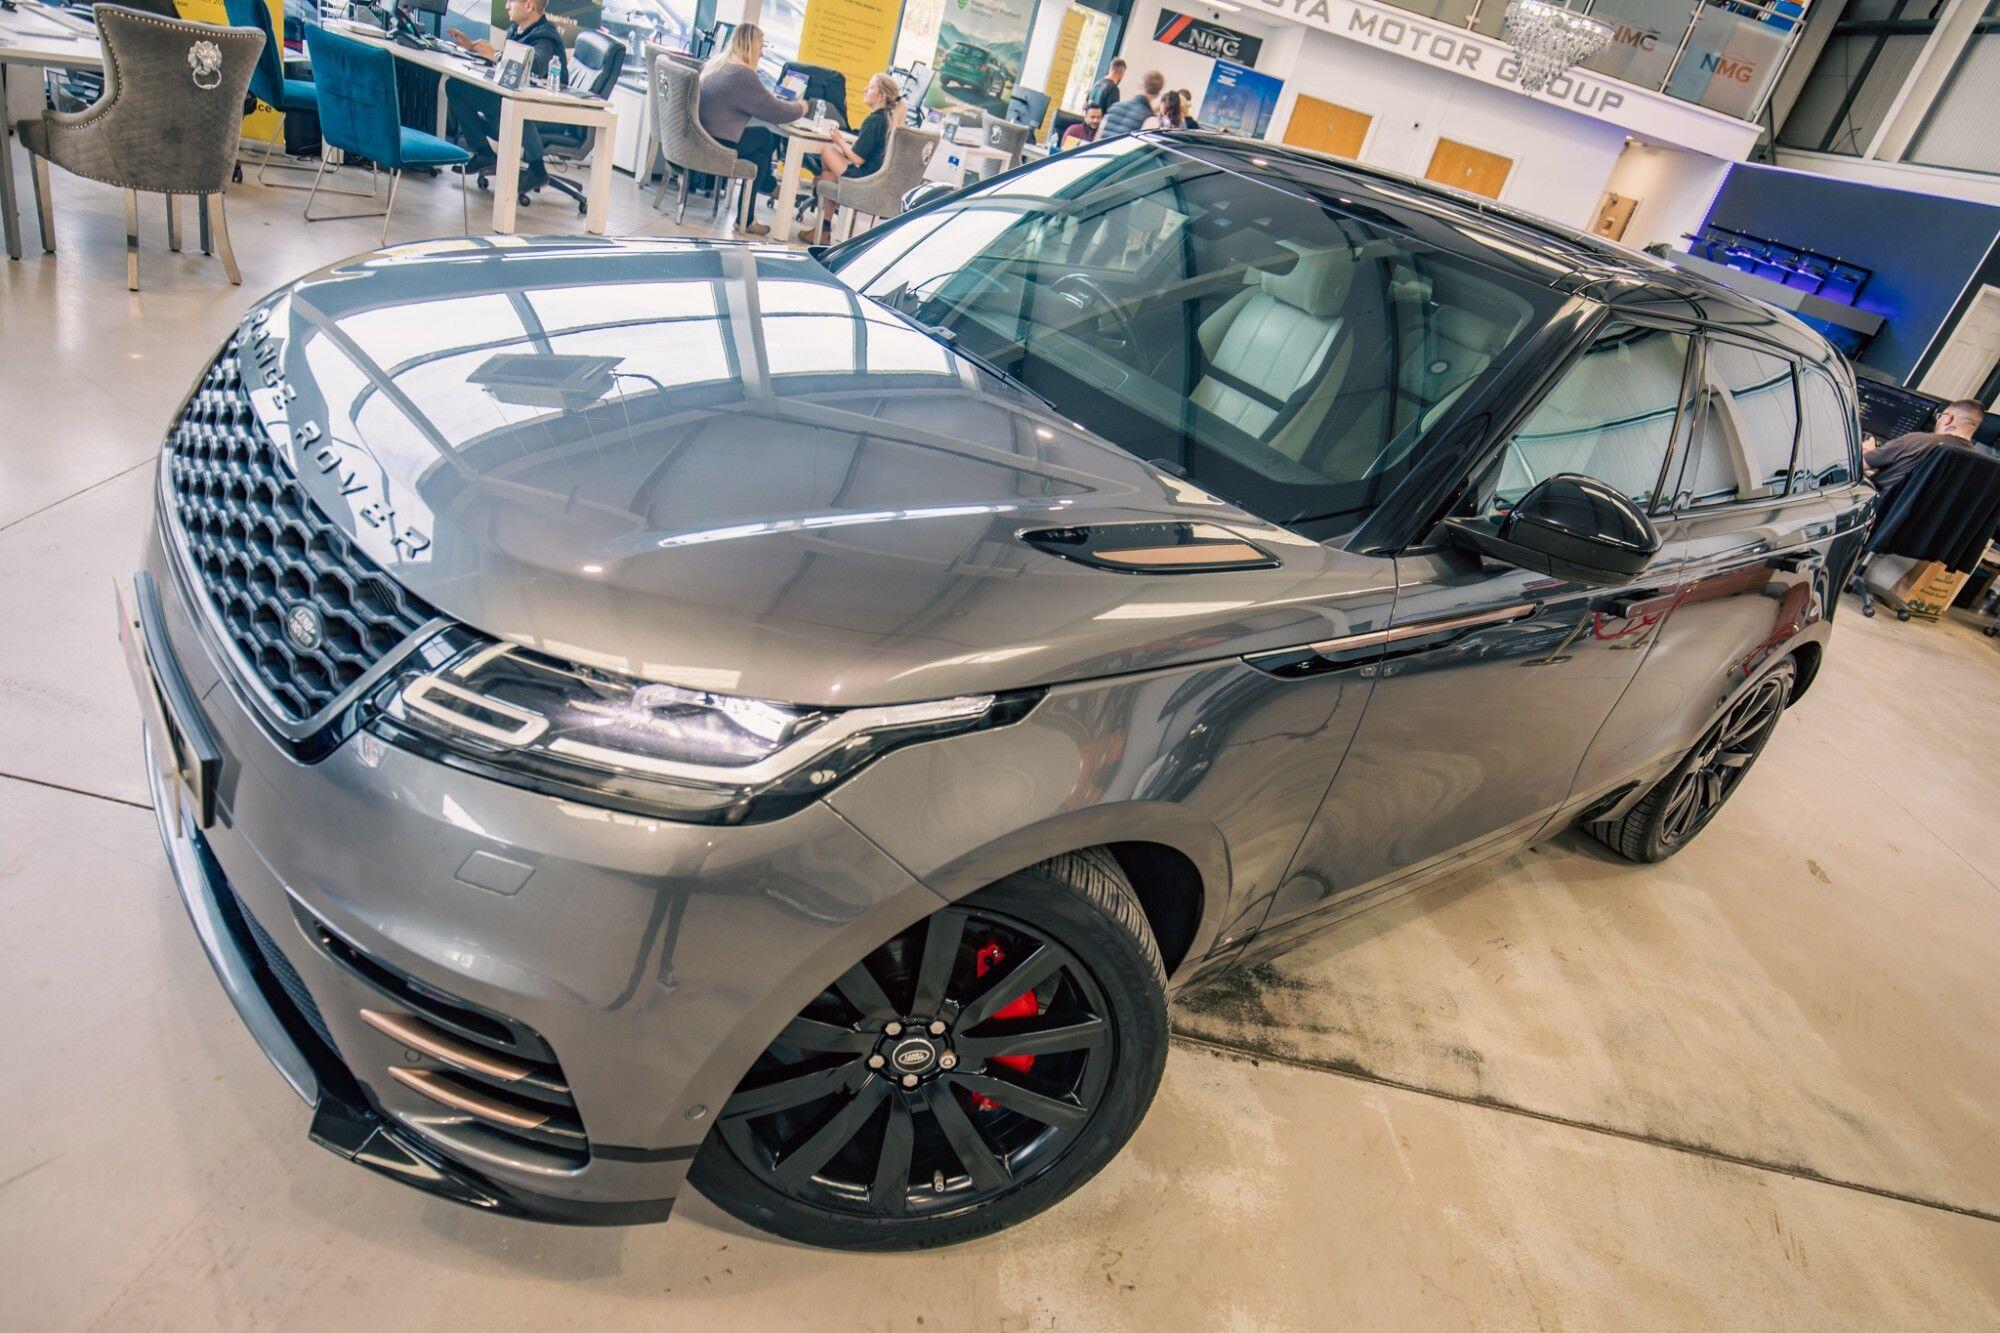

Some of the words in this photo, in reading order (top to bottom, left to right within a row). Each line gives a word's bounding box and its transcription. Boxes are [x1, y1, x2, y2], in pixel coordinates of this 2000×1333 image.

[1188, 28, 1240, 57] NMG
[1348, 8, 1482, 70] MOTOR
[1496, 57, 1624, 112] GOUP
[1699, 53, 1752, 82] NMG
[249, 307, 298, 411] RANGE
[295, 419, 431, 560] ROVER
